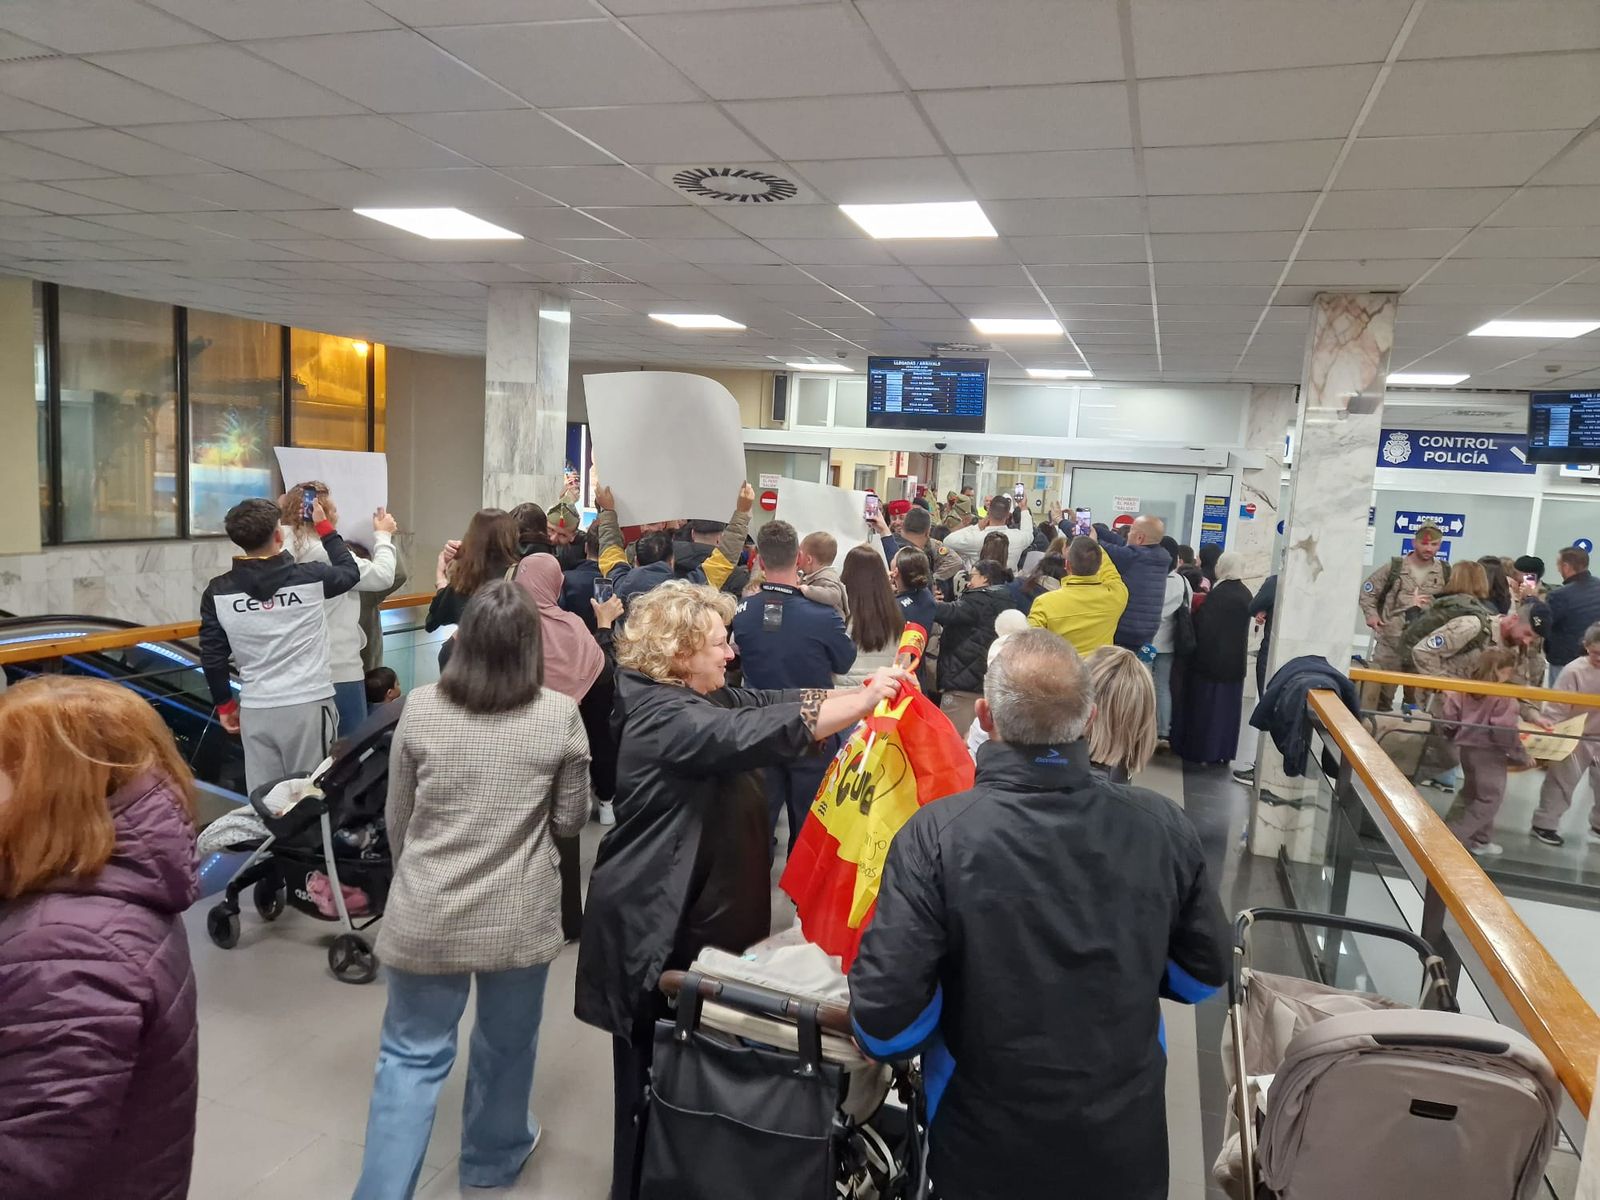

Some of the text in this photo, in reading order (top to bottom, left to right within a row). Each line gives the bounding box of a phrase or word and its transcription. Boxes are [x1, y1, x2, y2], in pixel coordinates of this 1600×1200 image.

[1418, 435, 1499, 450] CONTROL
[1423, 450, 1489, 465] POLICÍA
[232, 591, 303, 613] CEUTA
